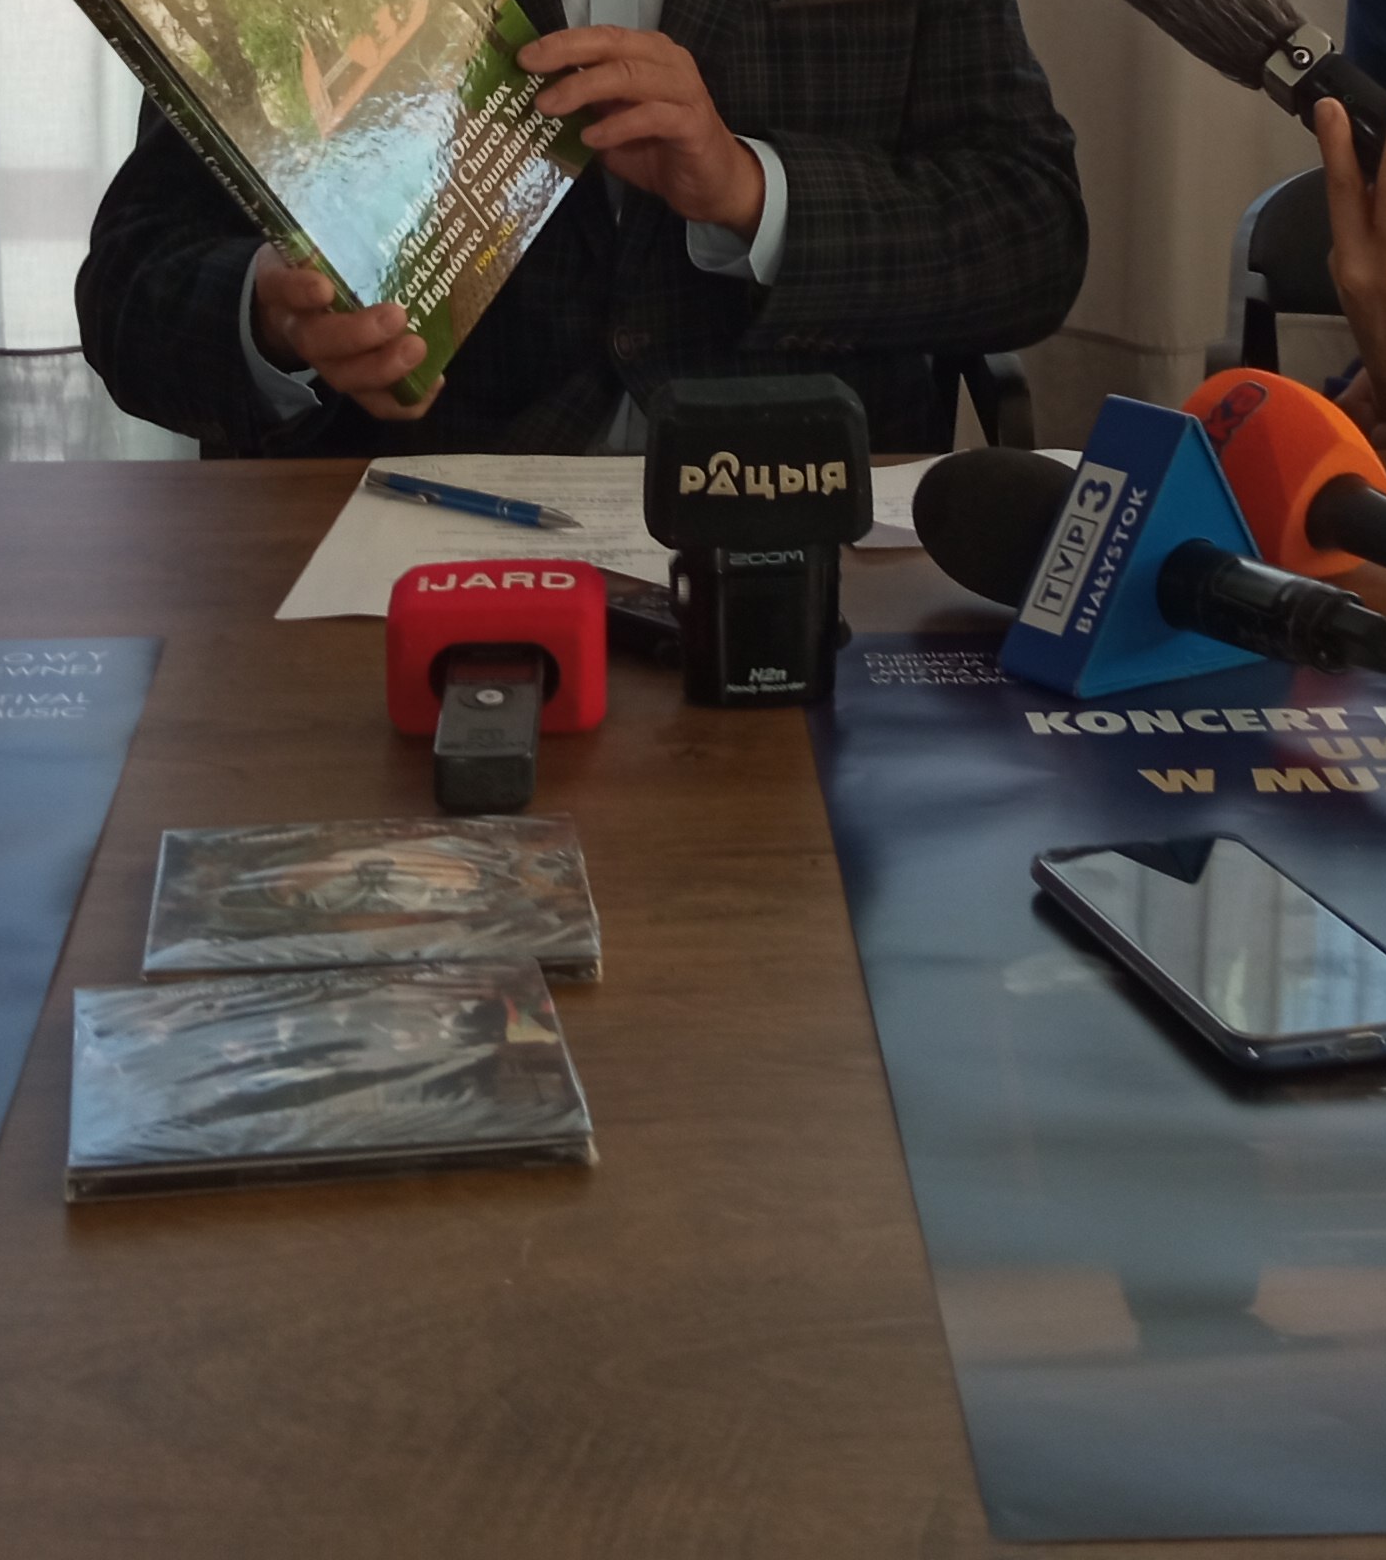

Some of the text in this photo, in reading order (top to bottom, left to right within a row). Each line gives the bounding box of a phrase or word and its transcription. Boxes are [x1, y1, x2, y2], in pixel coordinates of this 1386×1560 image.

[450, 81, 514, 161] Orthodox
[458, 73, 546, 185] Church Music
[486, 197, 506, 224] in
[417, 228, 484, 317] Hajnówce
[729, 550, 804, 566] ZOOM
[1075, 487, 1147, 634] BIAŁYSTOK
[1025, 706, 1349, 736] KONCERT
[1137, 768, 1215, 793] W
